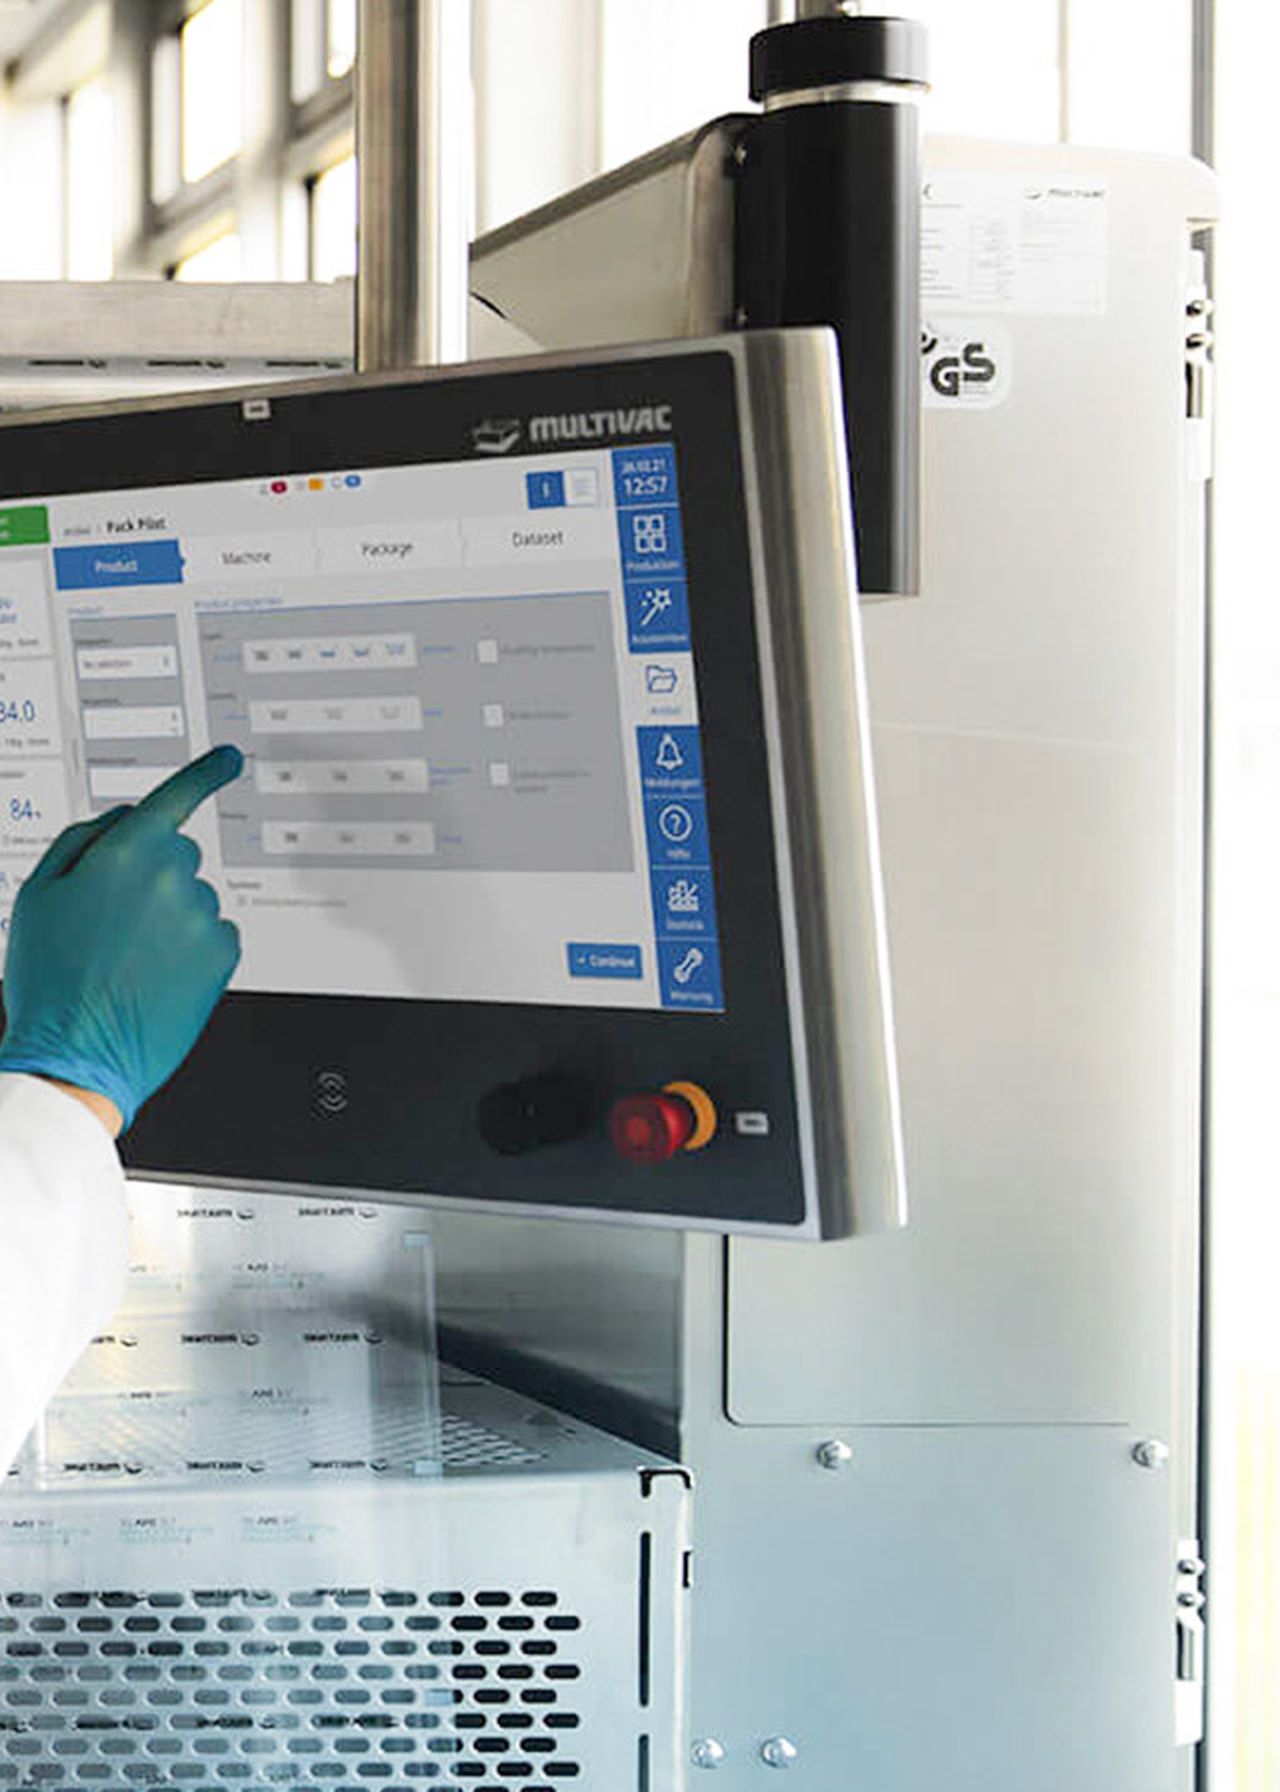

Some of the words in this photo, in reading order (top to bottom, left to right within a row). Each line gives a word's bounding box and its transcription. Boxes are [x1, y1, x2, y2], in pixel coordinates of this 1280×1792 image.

[930, 342, 996, 397] GS
[530, 406, 672, 442] MULTIVAC
[624, 475, 668, 496] 12:57
[511, 530, 564, 548] Dataset
[220, 550, 273, 566] Machine
[361, 542, 414, 560] Package
[94, 557, 138, 574] Product
